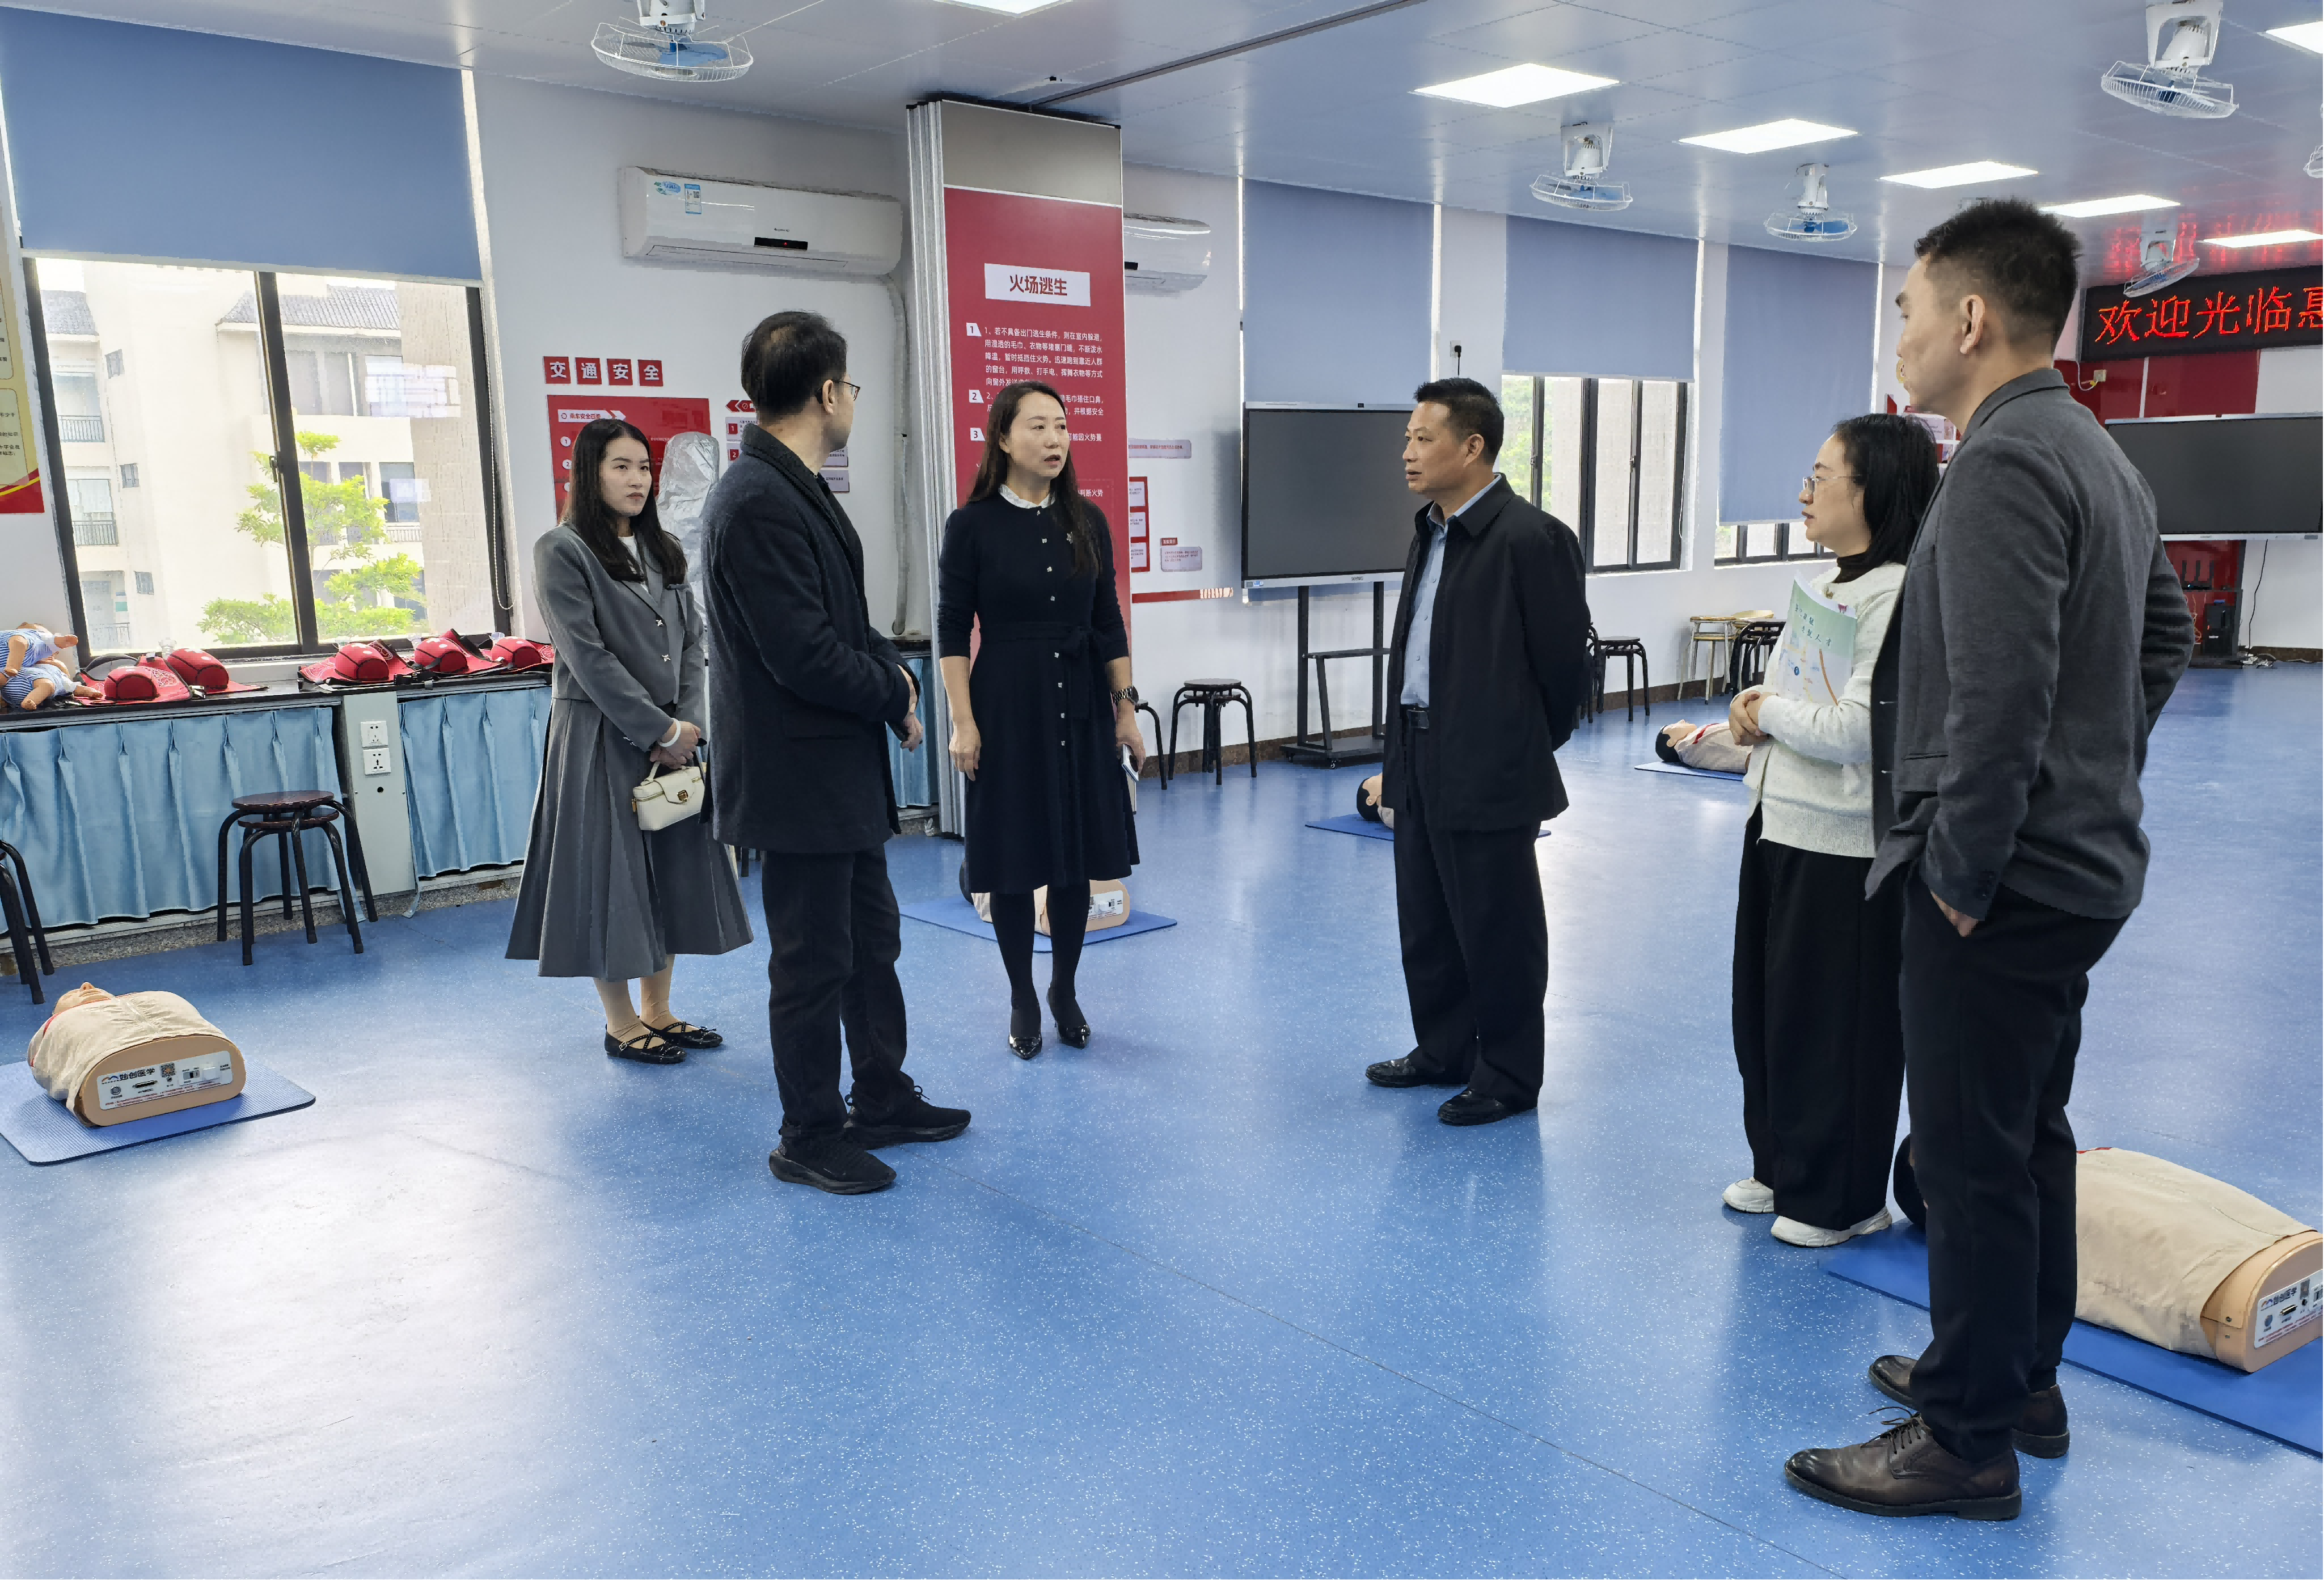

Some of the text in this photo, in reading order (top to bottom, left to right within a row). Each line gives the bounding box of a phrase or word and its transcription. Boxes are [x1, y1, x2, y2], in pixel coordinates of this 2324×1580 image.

[1009, 274, 1068, 297] 火场逃生
[550, 361, 660, 381] 交通安全
